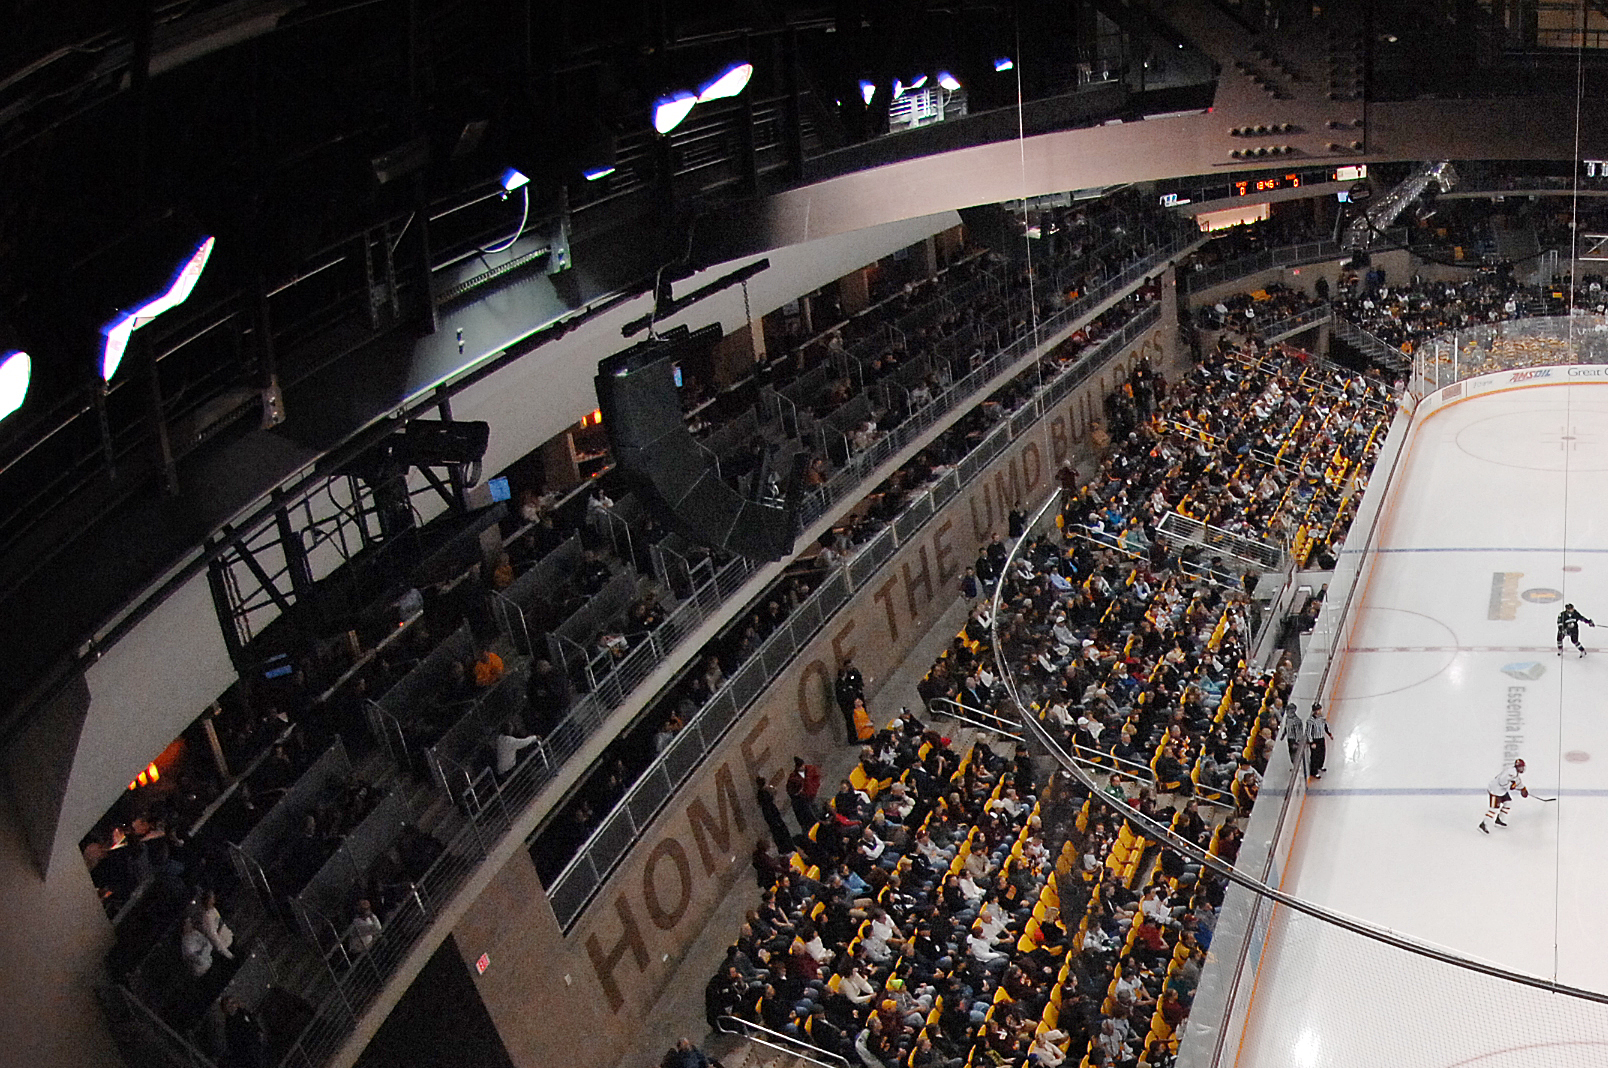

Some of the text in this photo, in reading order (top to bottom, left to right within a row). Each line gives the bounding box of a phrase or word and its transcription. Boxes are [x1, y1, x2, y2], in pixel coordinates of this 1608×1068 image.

[1509, 369, 1551, 382] AMSOIL
[1568, 367, 1600, 377] Great
[1506, 685, 1527, 732] Essentia
[585, 714, 785, 1016] HOME
[797, 620, 857, 735] OF
[873, 520, 958, 643] THE
[970, 441, 1040, 541] UMD
